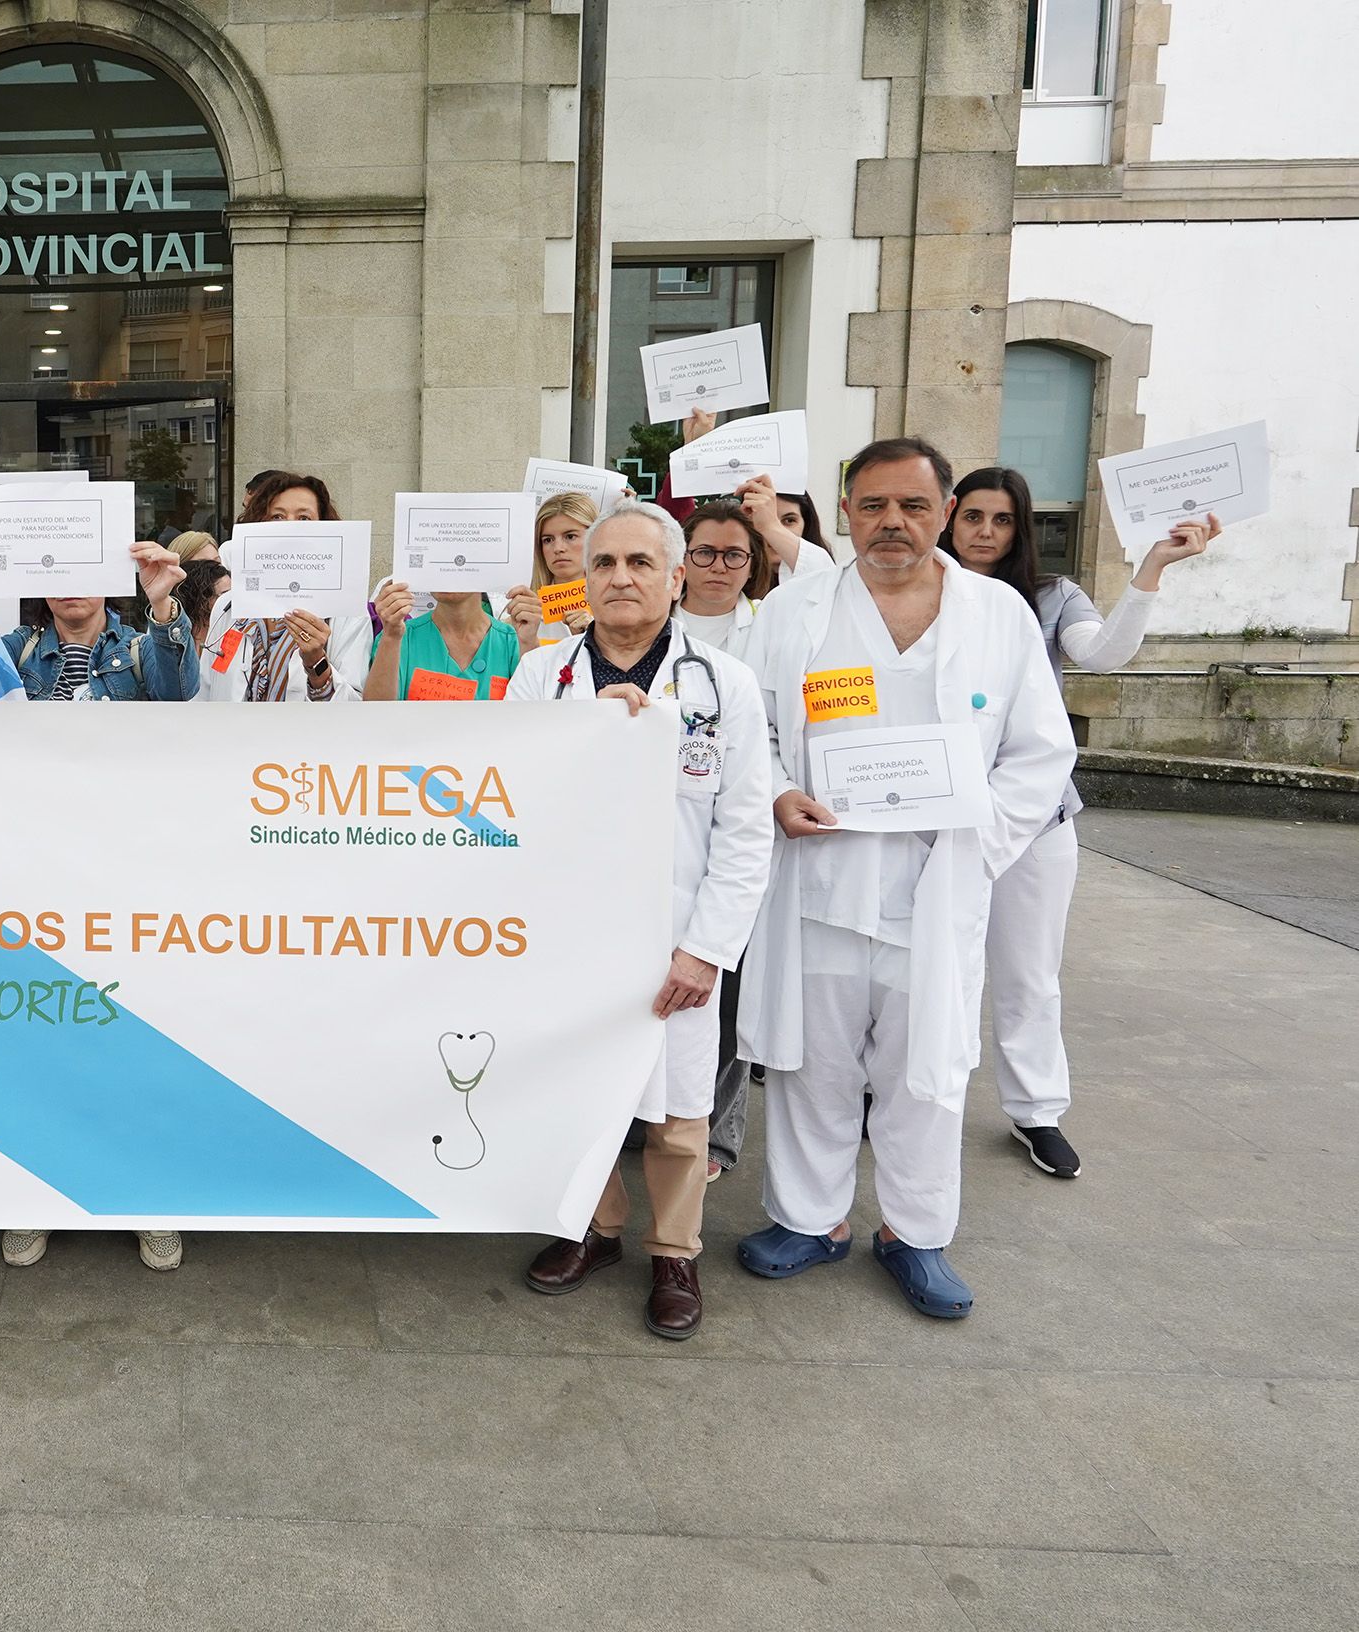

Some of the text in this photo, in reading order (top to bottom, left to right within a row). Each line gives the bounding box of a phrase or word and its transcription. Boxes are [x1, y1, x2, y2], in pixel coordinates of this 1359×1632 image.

[669, 365, 727, 380] HORA COMPUTADA
[671, 358, 723, 373] HORA TRABAJADA
[715, 443, 764, 453] CONDICIONES
[1128, 461, 1229, 489] ME OBLIGAN A TRABAJAR
[1152, 476, 1213, 494] 24H SEGUIDAS
[255, 553, 289, 561] DERECHO
[297, 553, 334, 561] NEGOCIAR
[276, 563, 326, 571] CONDICIONES
[541, 585, 587, 604] SERVICIO
[548, 600, 590, 616] MÍNIMO
[802, 675, 875, 695] SERVICIOS
[811, 694, 870, 712] MÍNIMOS
[848, 758, 924, 773] HORA TRABAJADA
[846, 769, 930, 784] HORA COMPUTADA
[250, 825, 519, 848] Sindicato Médico de Galicia
[84, 912, 113, 952] E
[131, 912, 528, 957] FACULTATIVOS
